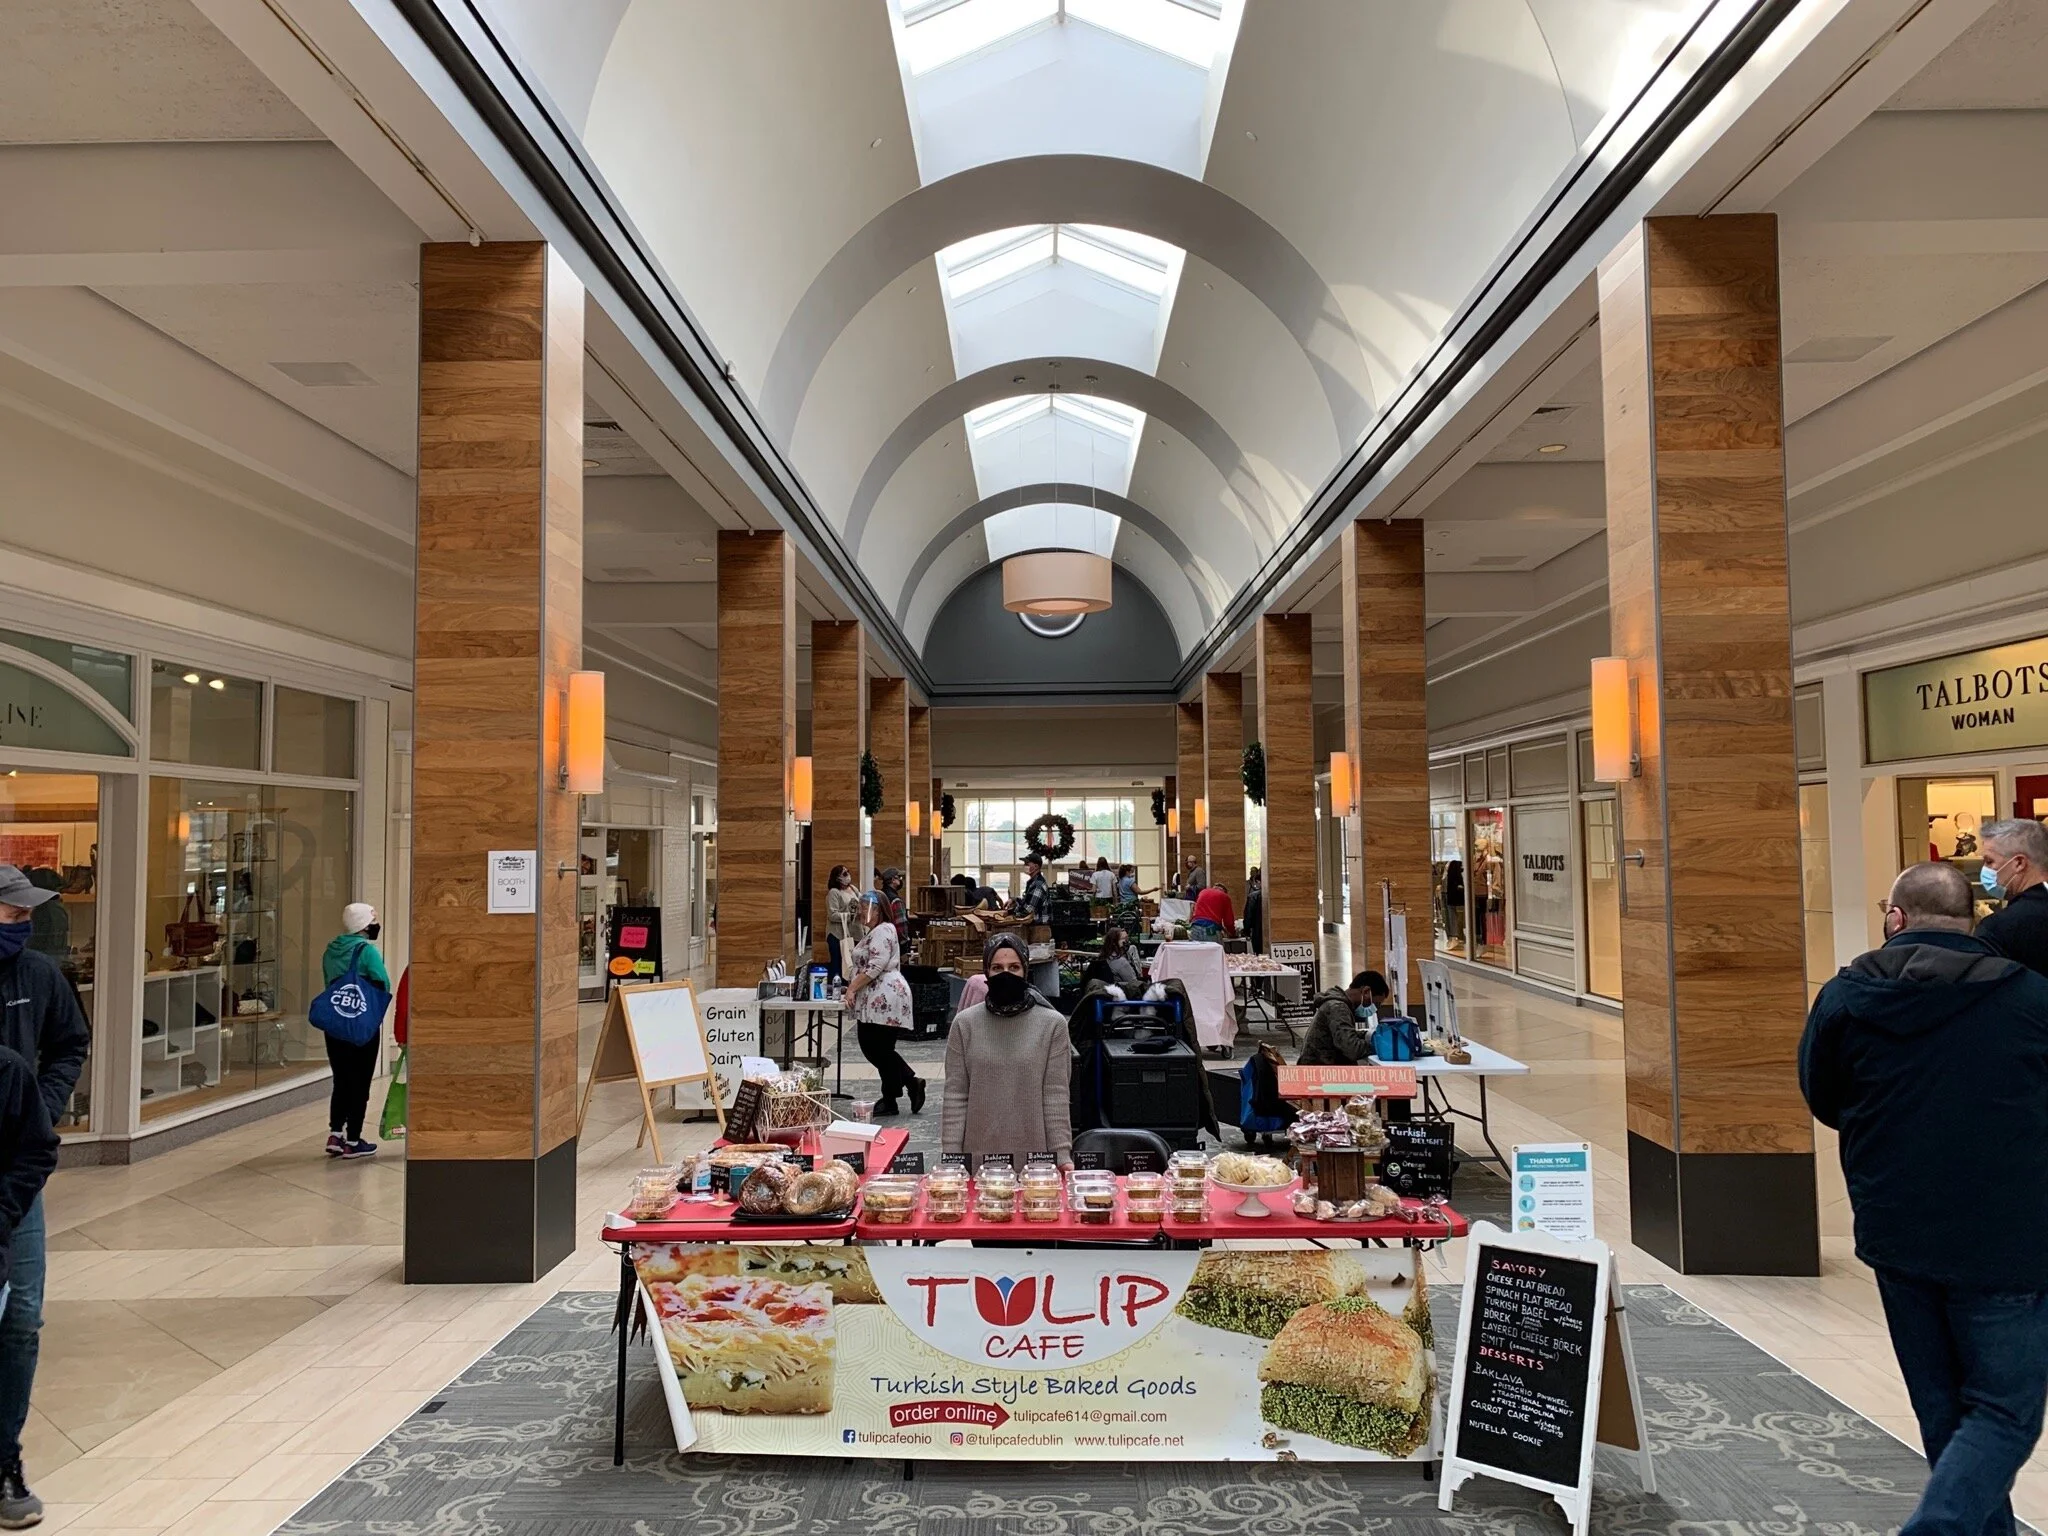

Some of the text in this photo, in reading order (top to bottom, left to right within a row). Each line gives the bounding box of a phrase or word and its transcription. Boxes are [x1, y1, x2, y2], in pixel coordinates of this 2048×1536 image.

[1916, 662, 2048, 711] TALBOTS
[0, 703, 43, 729] INE
[1951, 707, 2015, 730] WOMAN
[1522, 854, 1565, 871] TALBOTS
[497, 878, 526, 886] BOOTH
[1273, 946, 1313, 959] tupelo
[330, 994, 367, 1012] CBUS
[706, 1006, 747, 1020] Grain
[706, 1028, 755, 1042] Gluten
[1280, 1069, 1413, 1083] BAKE THE WORLD A BETTER PLACE
[1388, 1125, 1427, 1137] Turkish
[1529, 1157, 1554, 1165] THANK
[1491, 1260, 1547, 1278] SAVORY
[1486, 1273, 1566, 1298] CHEESE FLAT BREAD
[906, 1274, 1170, 1328] TULIP
[1484, 1296, 1519, 1313] TURKISH
[1521, 1304, 1550, 1321] BAGEL
[1485, 1285, 1573, 1314] SPINACH FLAT BREAD
[1481, 1321, 1518, 1338] LAYERED
[1521, 1330, 1550, 1347] CHEESE
[985, 1334, 1085, 1361] CAFE
[1479, 1345, 1545, 1371] DESSERTS
[1472, 1361, 1525, 1387] BAKLAVA
[870, 1375, 1198, 1405] Turkish Style Baked Goods
[1497, 1381, 1533, 1397] PISTACHIO
[1470, 1399, 1503, 1415] CARROT
[1507, 1409, 1531, 1423] CAKE
[1497, 1388, 1575, 1417] TRADITIONAL WALNUT
[1521, 1404, 1555, 1420] SEMOLINA
[893, 1404, 1168, 1425] order online tulipcafe614@gmail.com
[858, 1431, 1185, 1450] tulipcafeohio @tulipcafedublin www.tulipcafe.net
[1468, 1419, 1544, 1447] NUTELLA COOKIE
